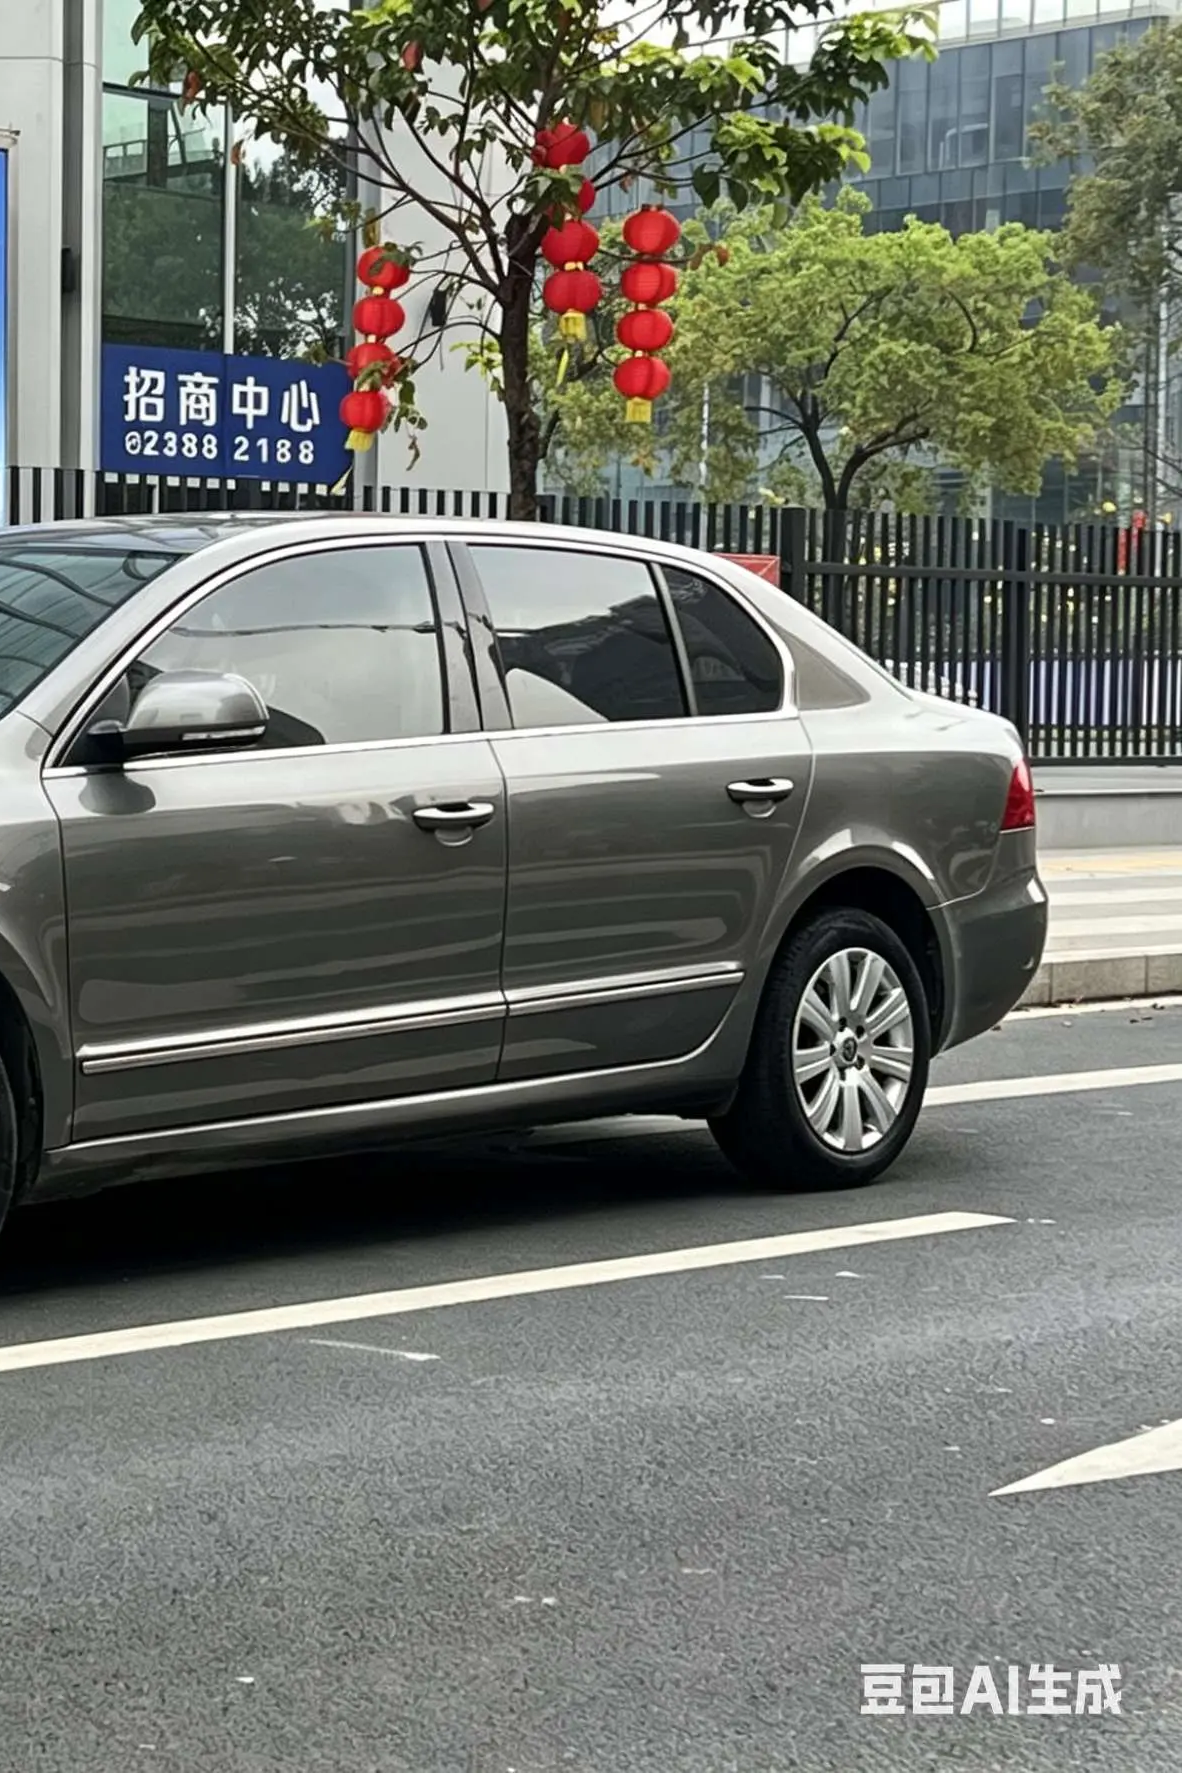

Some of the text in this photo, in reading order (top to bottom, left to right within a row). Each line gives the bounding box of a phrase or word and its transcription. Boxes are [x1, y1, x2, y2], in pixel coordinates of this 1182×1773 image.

[123, 366, 320, 433] 招商中心
[233, 436, 315, 465] 2188
